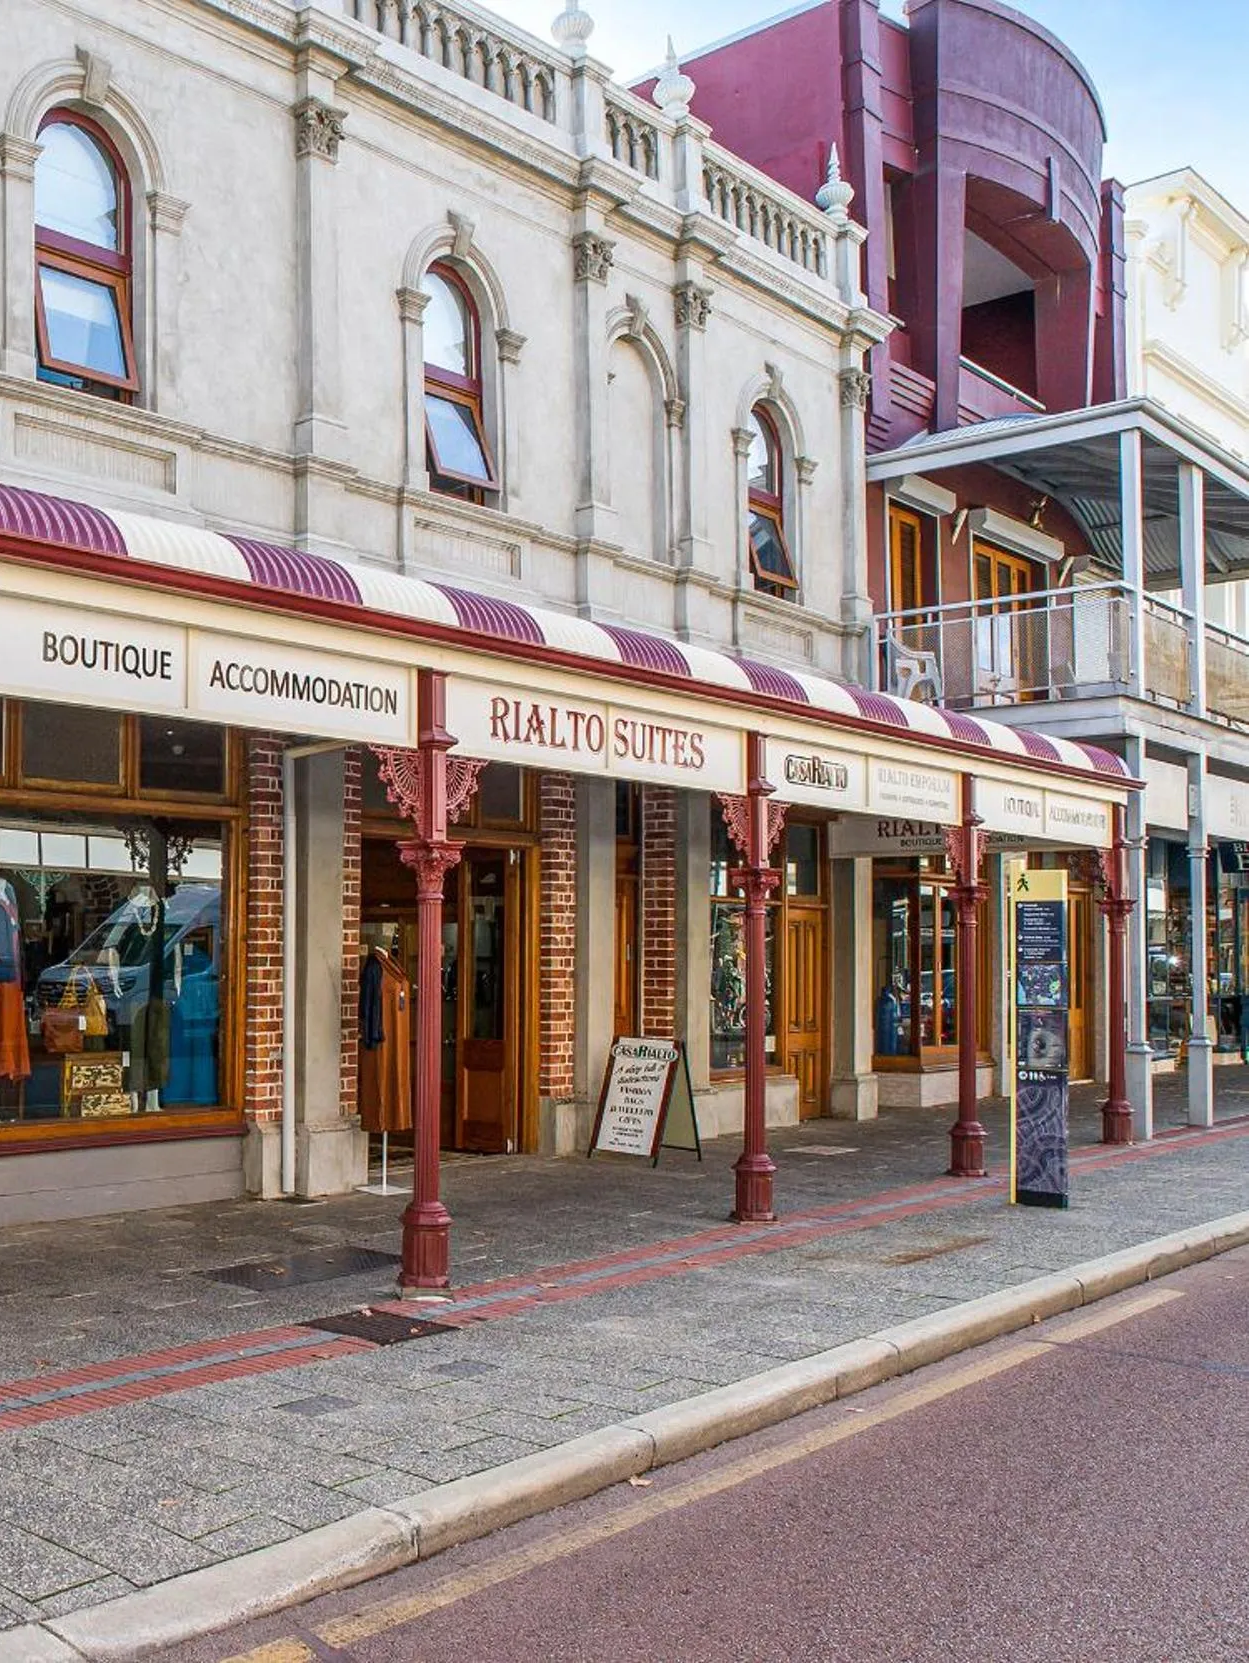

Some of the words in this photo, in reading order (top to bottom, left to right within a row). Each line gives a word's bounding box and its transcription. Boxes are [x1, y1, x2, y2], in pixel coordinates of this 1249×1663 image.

[42, 631, 173, 681] BOUTIQUE
[209, 660, 399, 715] ACCOMMODATION
[490, 697, 606, 754] RIALTO
[613, 718, 706, 769] SUITES
